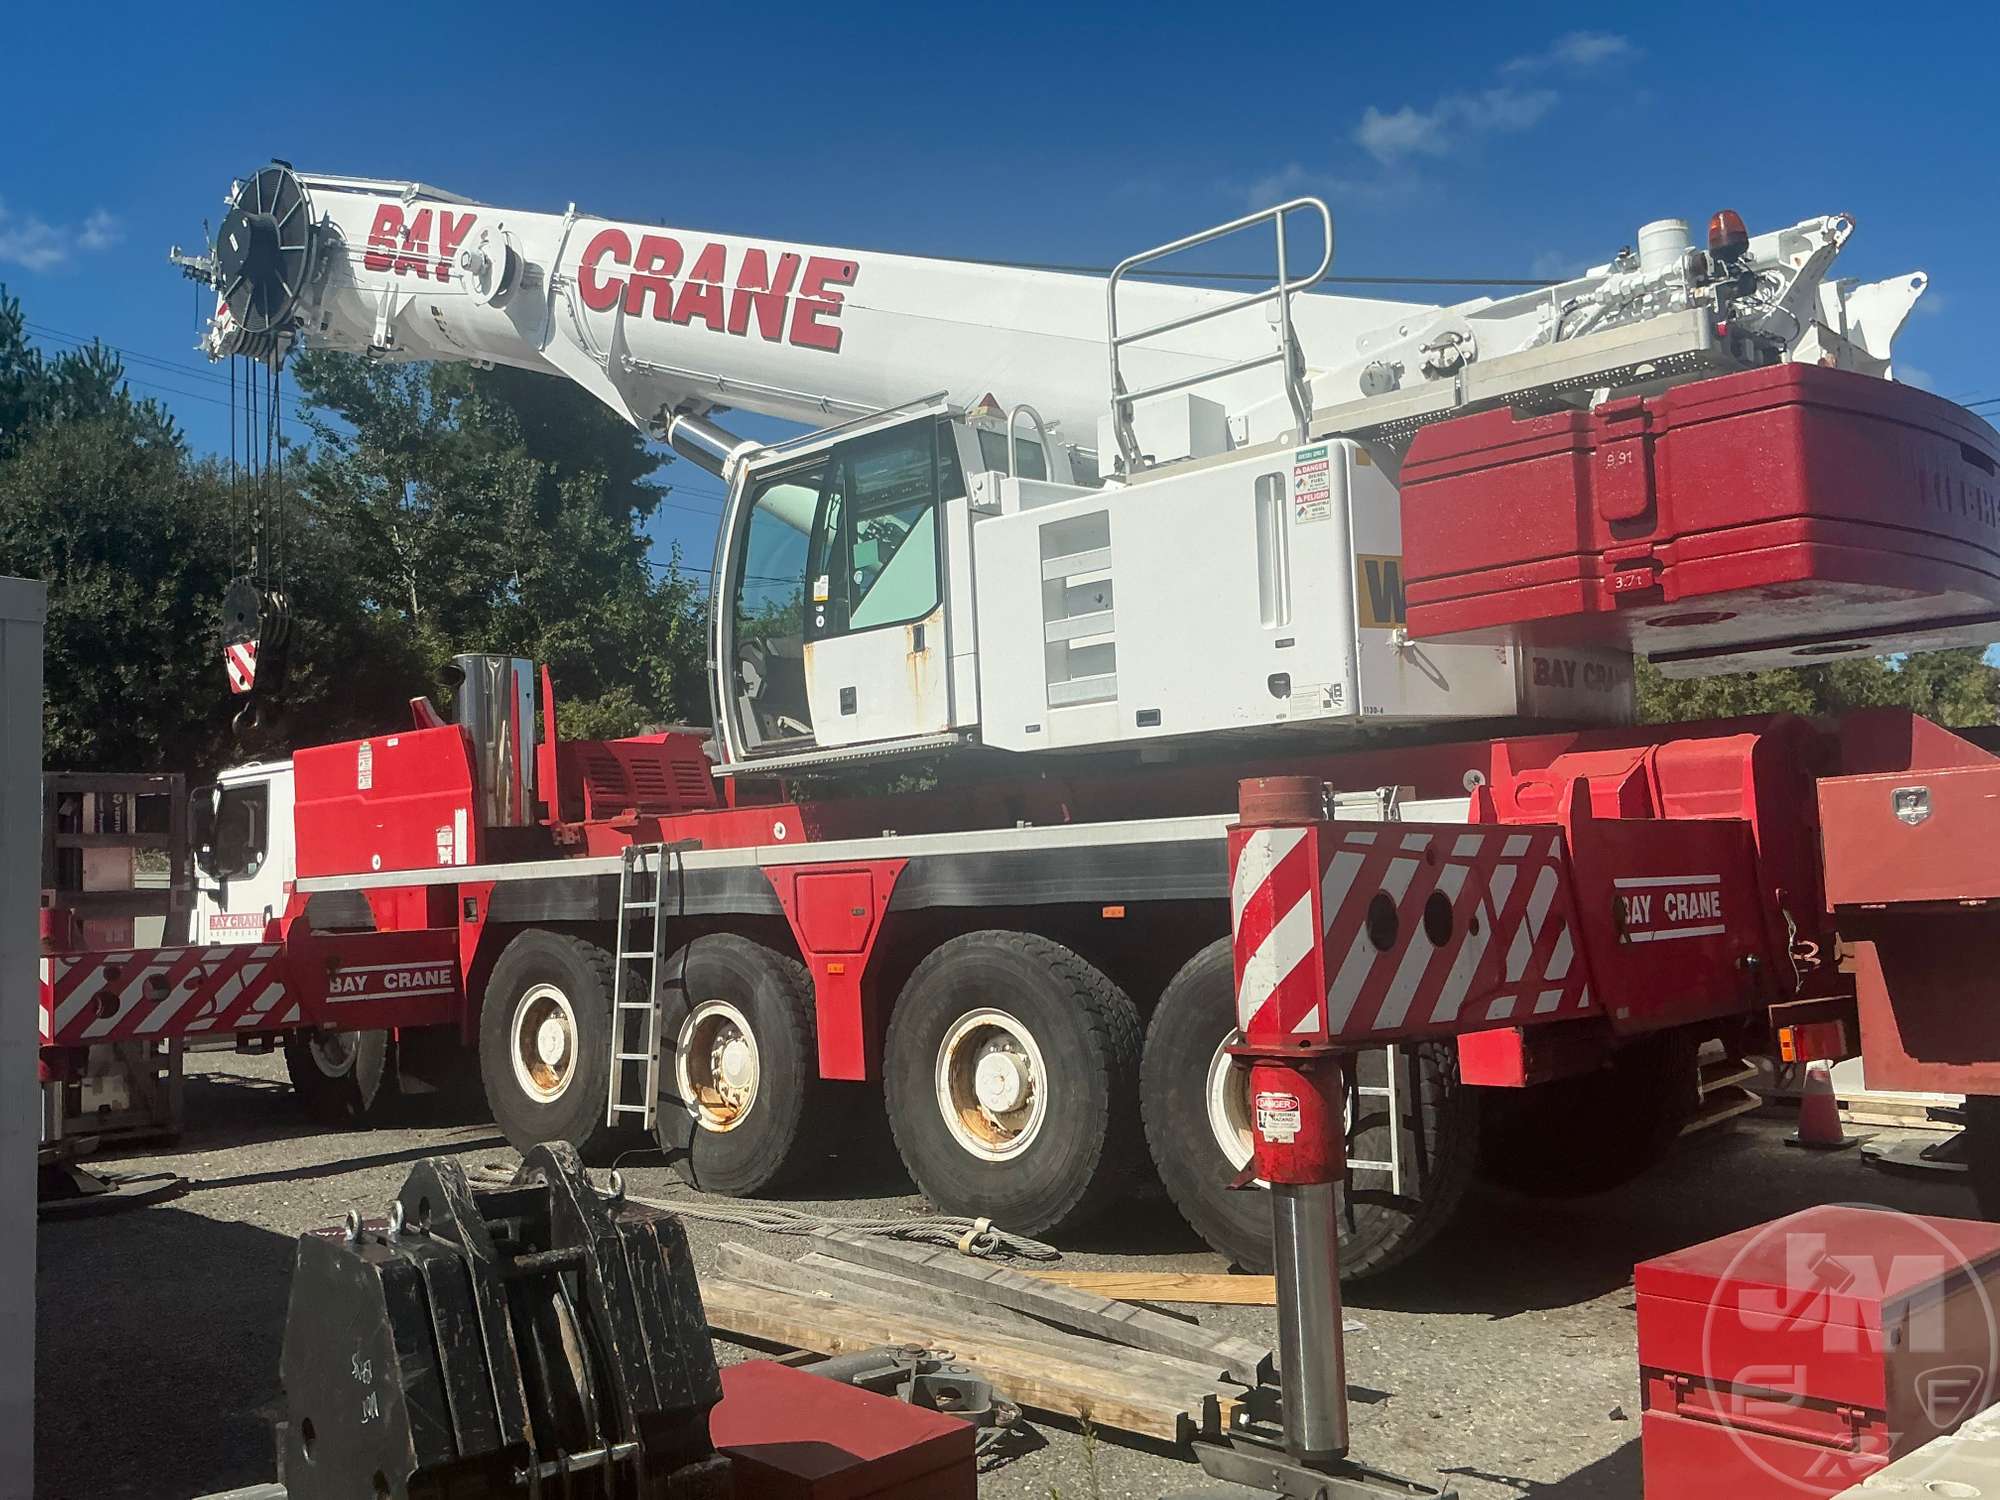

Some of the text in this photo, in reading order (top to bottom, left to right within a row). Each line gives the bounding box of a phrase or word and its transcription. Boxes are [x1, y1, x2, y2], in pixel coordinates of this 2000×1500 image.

[364, 204, 860, 354] BAY CRANE
[1302, 462, 1328, 474] DANGER
[1303, 491, 1329, 502] PELIGRO
[1533, 656, 1576, 689] BAY
[1664, 891, 1721, 921] CRANE
[329, 969, 452, 993] BAY CRANE
